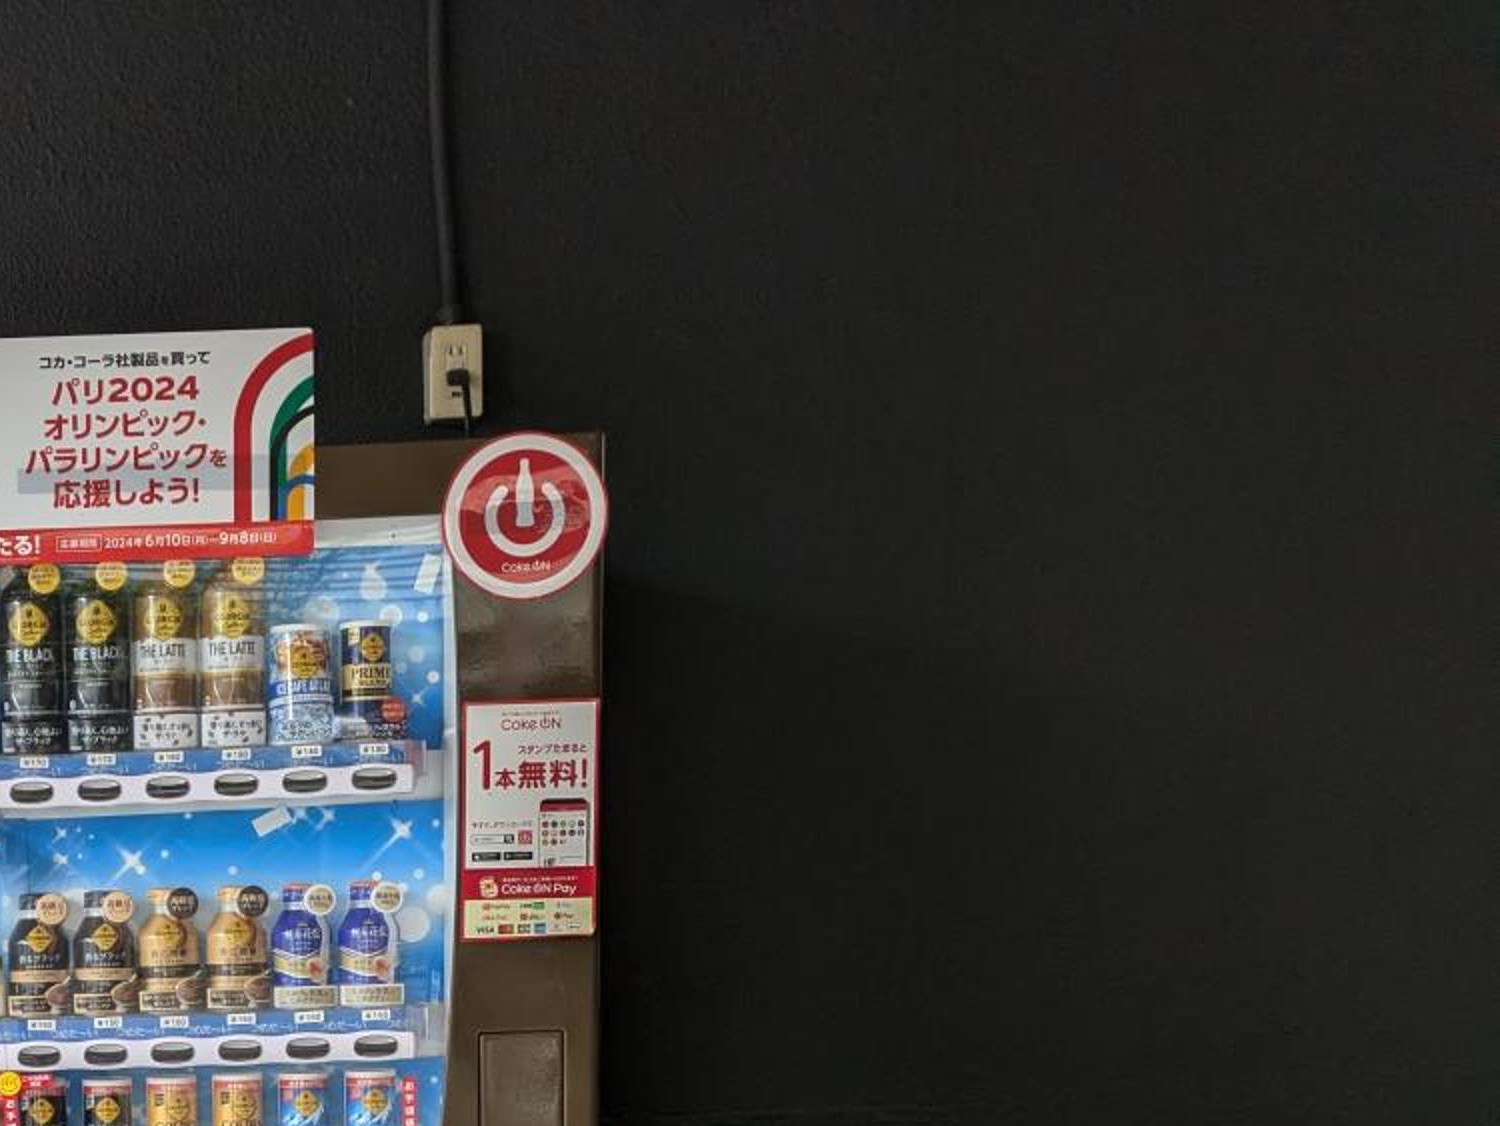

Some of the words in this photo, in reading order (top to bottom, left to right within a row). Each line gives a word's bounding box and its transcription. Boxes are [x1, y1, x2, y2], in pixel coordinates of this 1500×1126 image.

[39, 351, 211, 369] コカ・コーラ社製品を買って
[51, 375, 200, 406] パリ2024
[25, 442, 228, 475] パラリンピックを
[52, 477, 201, 509] 応援しよう!
[209, 642, 227, 655] THE
[229, 641, 256, 655] LATTE
[553, 883, 577, 896] Pay
